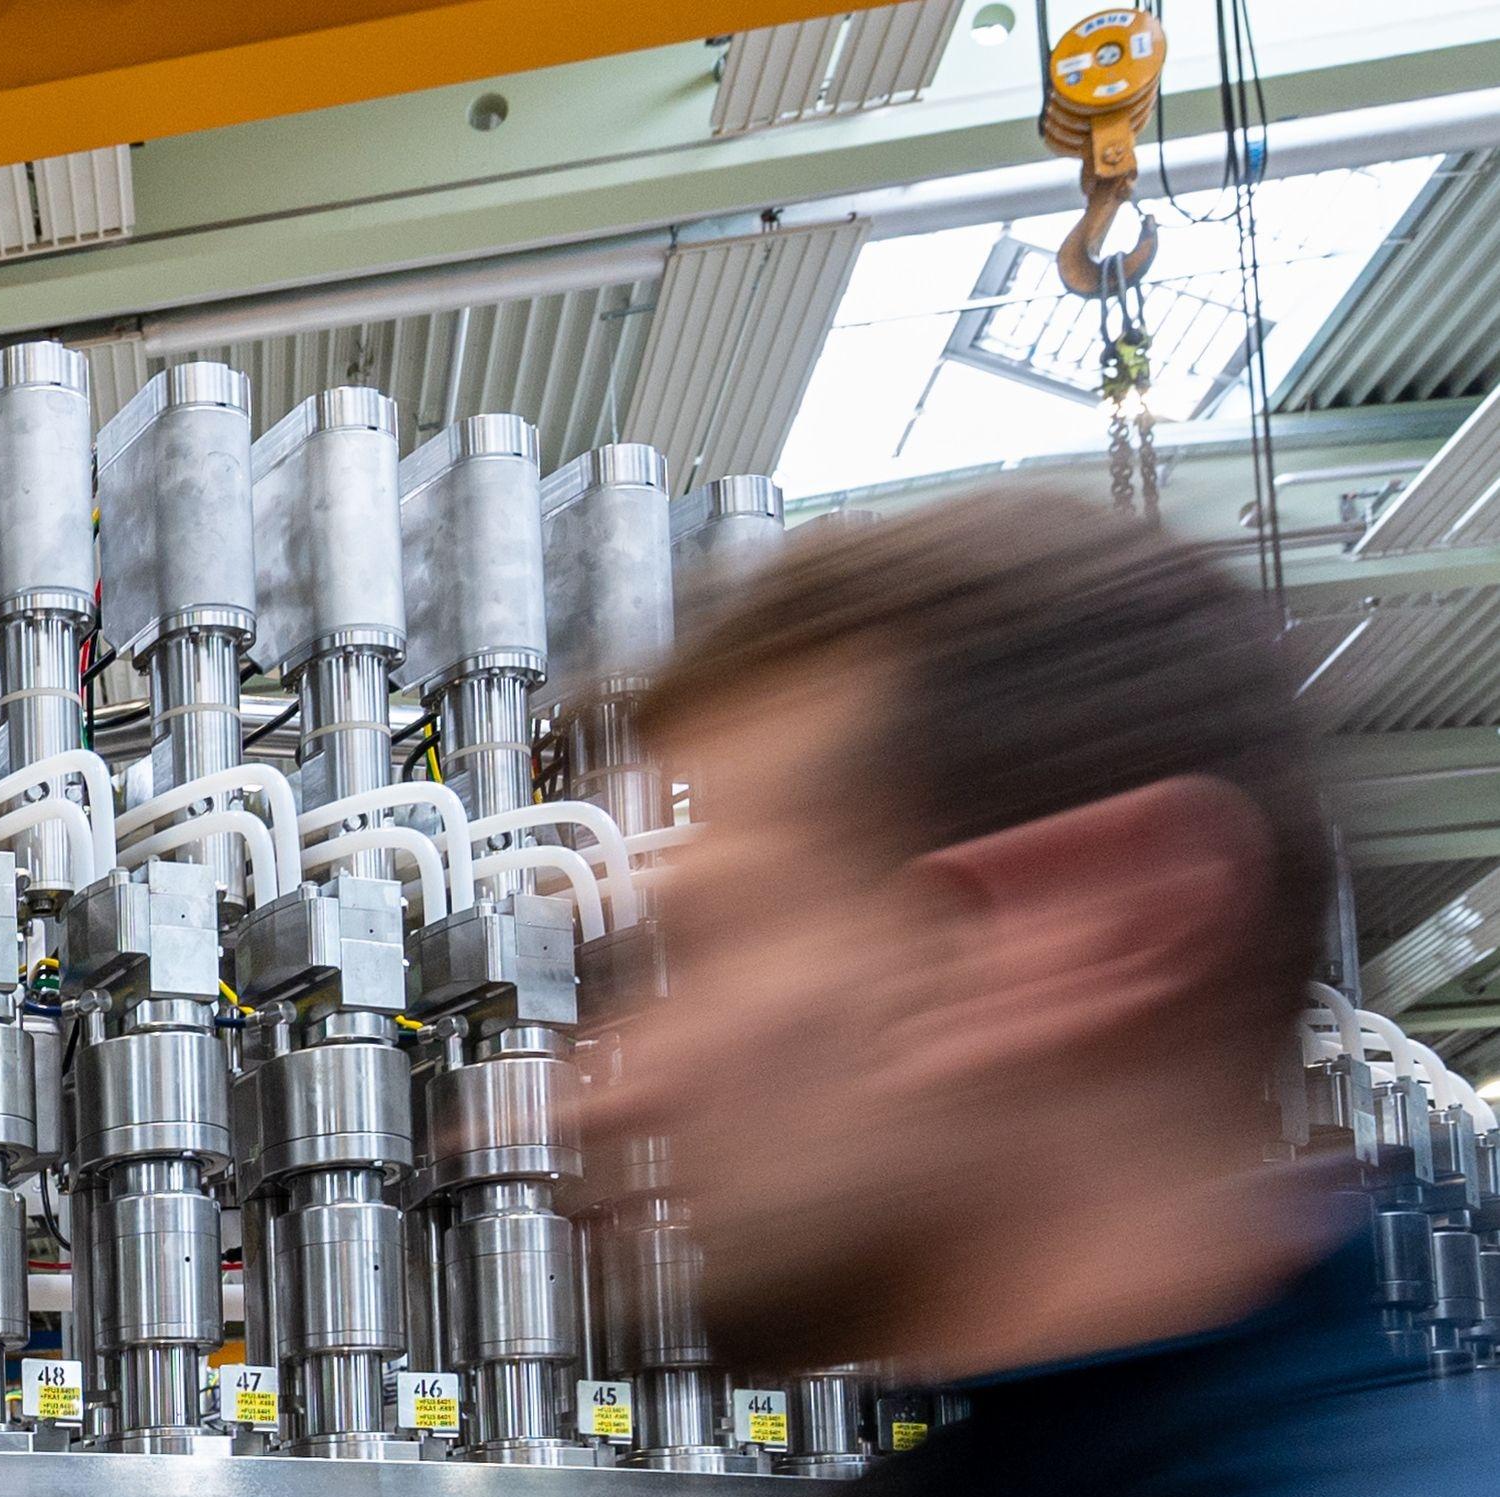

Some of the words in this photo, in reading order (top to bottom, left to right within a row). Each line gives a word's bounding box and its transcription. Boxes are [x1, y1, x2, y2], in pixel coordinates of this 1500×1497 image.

[38, 1366, 65, 1385] 48
[236, 1372, 262, 1391] 47
[414, 1380, 442, 1398] 46
[593, 1387, 616, 1406] 45
[749, 1396, 772, 1414] 44
